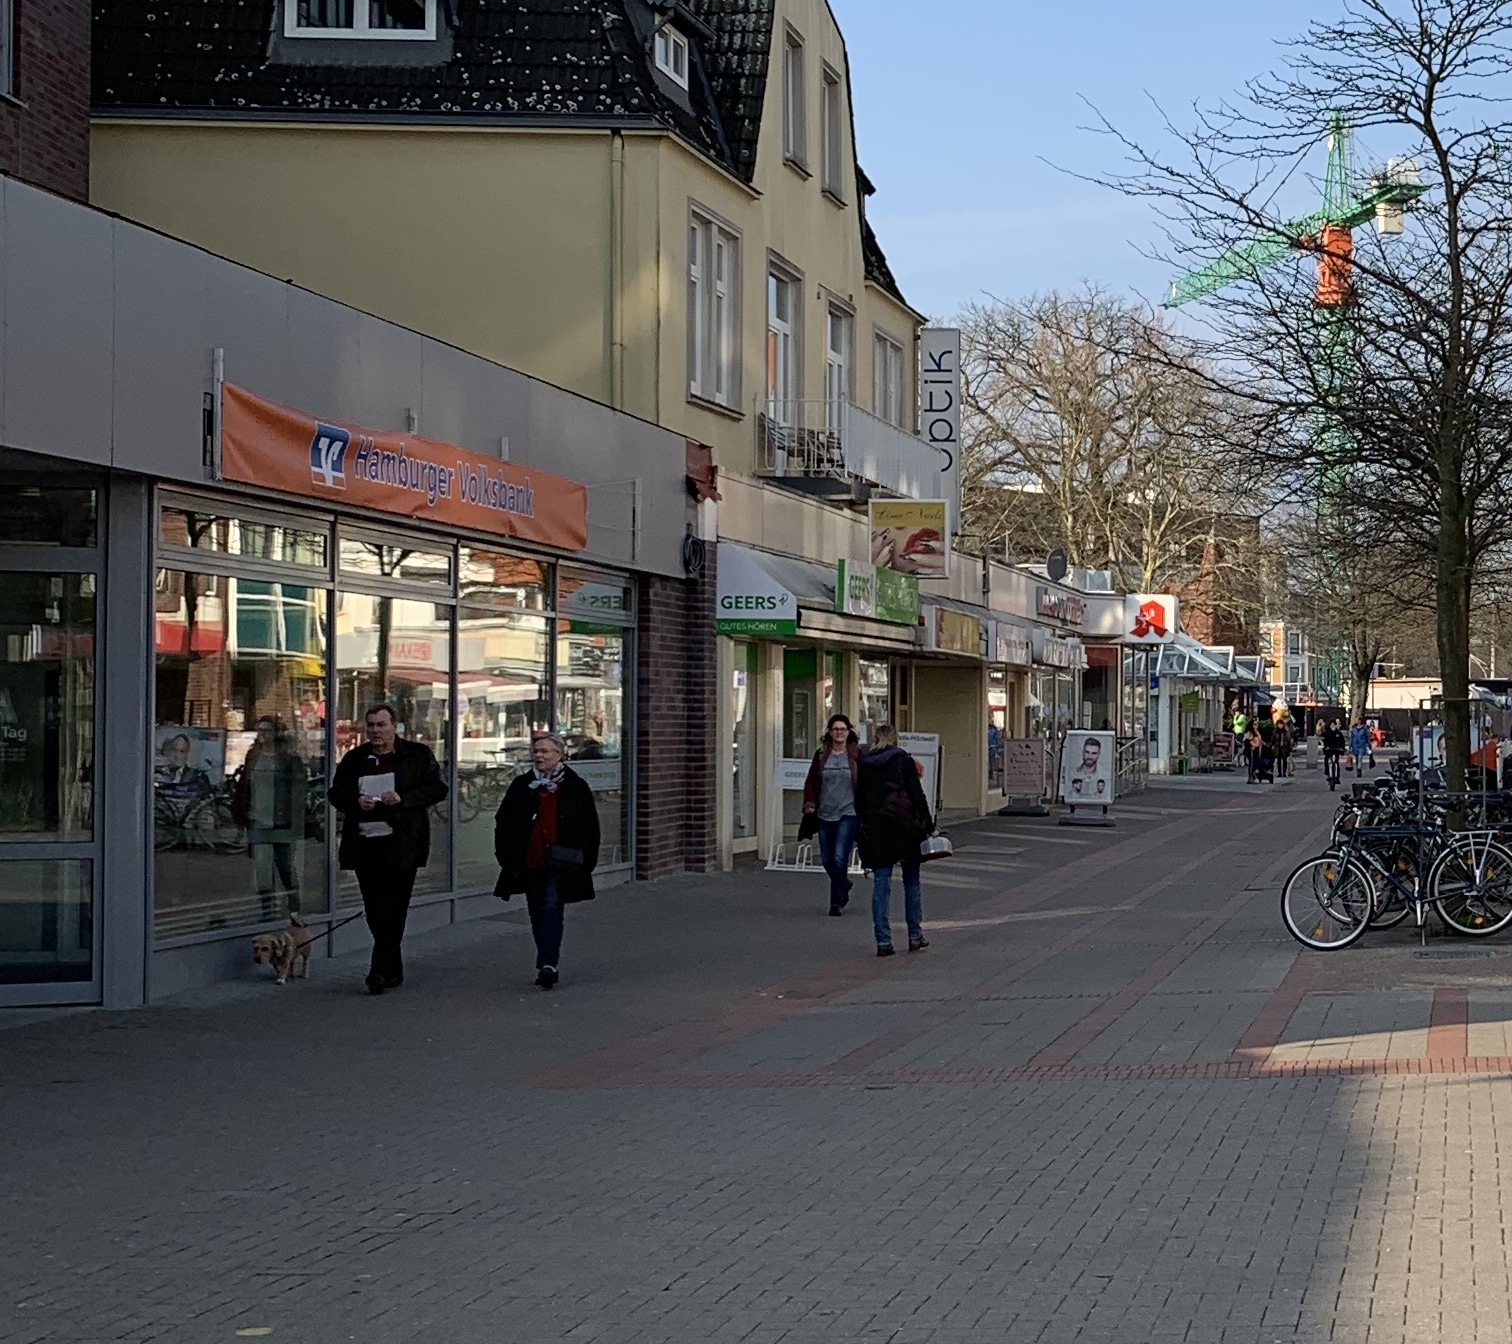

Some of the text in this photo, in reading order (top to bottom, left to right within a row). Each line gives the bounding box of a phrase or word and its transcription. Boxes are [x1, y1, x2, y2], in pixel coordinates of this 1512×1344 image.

[354, 435, 535, 518] Hamburger Volksbank
[720, 596, 777, 610] GEERS
[720, 621, 777, 631] GUTES HÖREN
[2, 726, 28, 741] Tag
